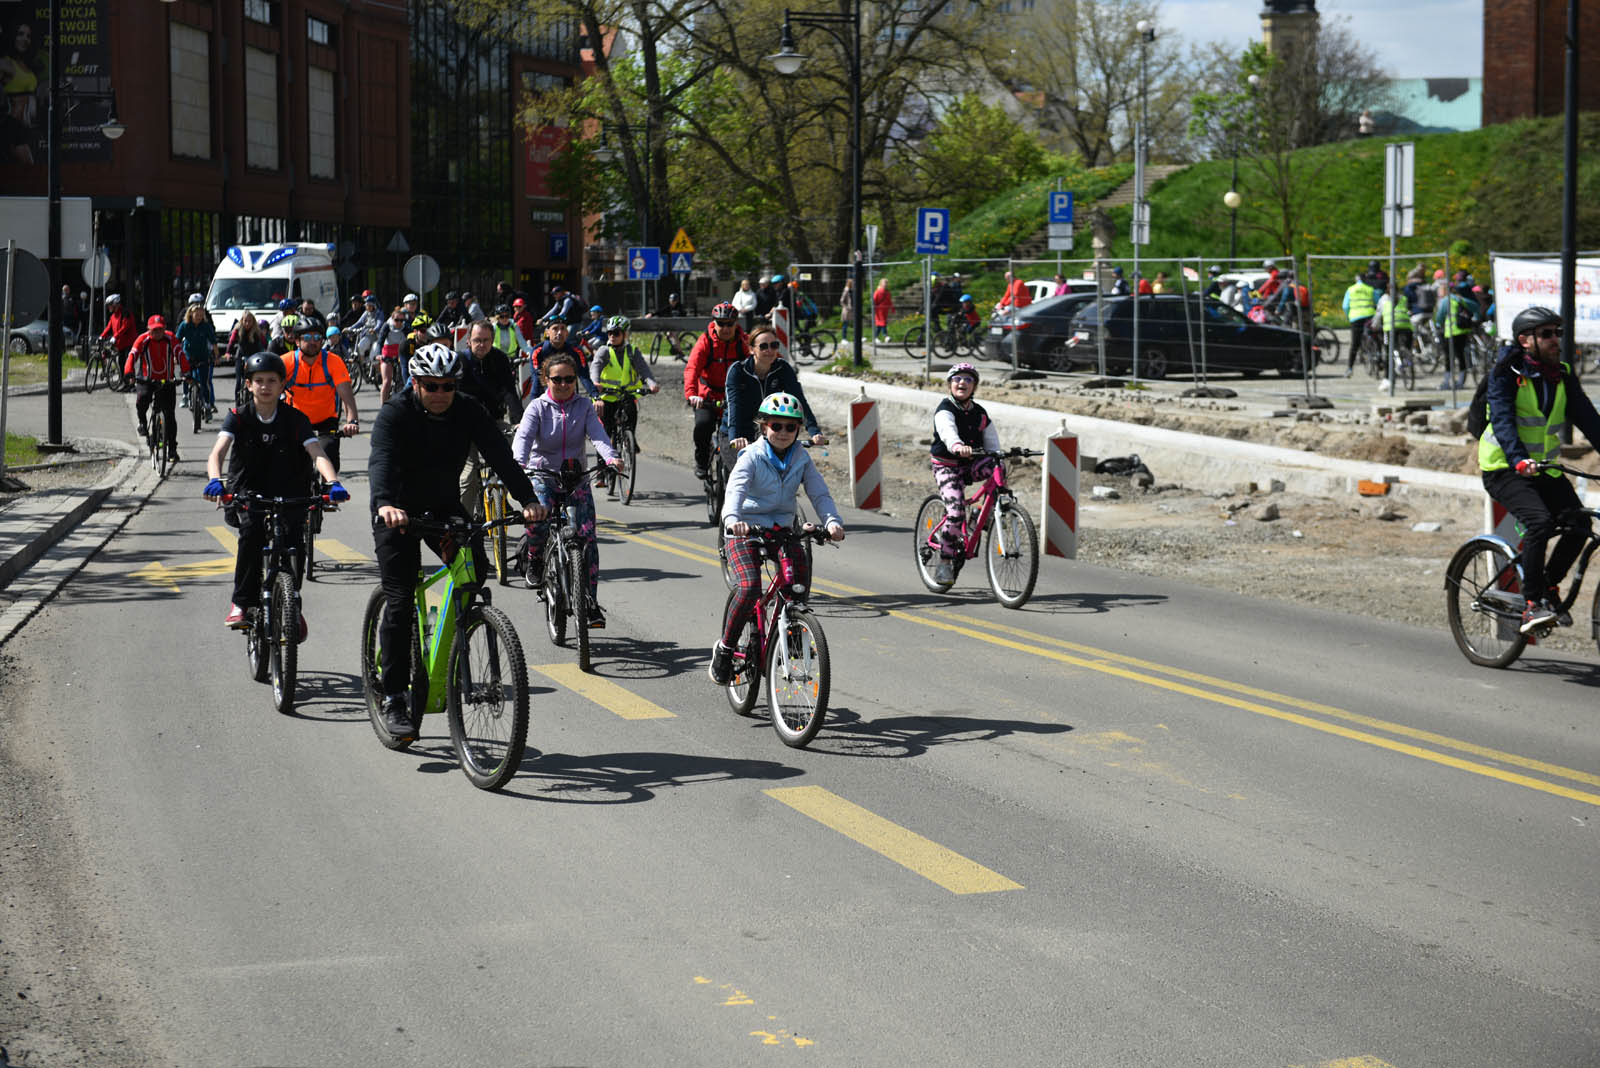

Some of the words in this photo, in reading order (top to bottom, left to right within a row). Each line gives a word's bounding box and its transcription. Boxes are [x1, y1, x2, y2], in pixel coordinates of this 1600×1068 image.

[36, 7, 97, 18] KODYCJA
[59, 21, 97, 31] TWOJE
[43, 34, 97, 46] ZROWIE
[1053, 194, 1069, 214] P
[924, 211, 944, 241] P
